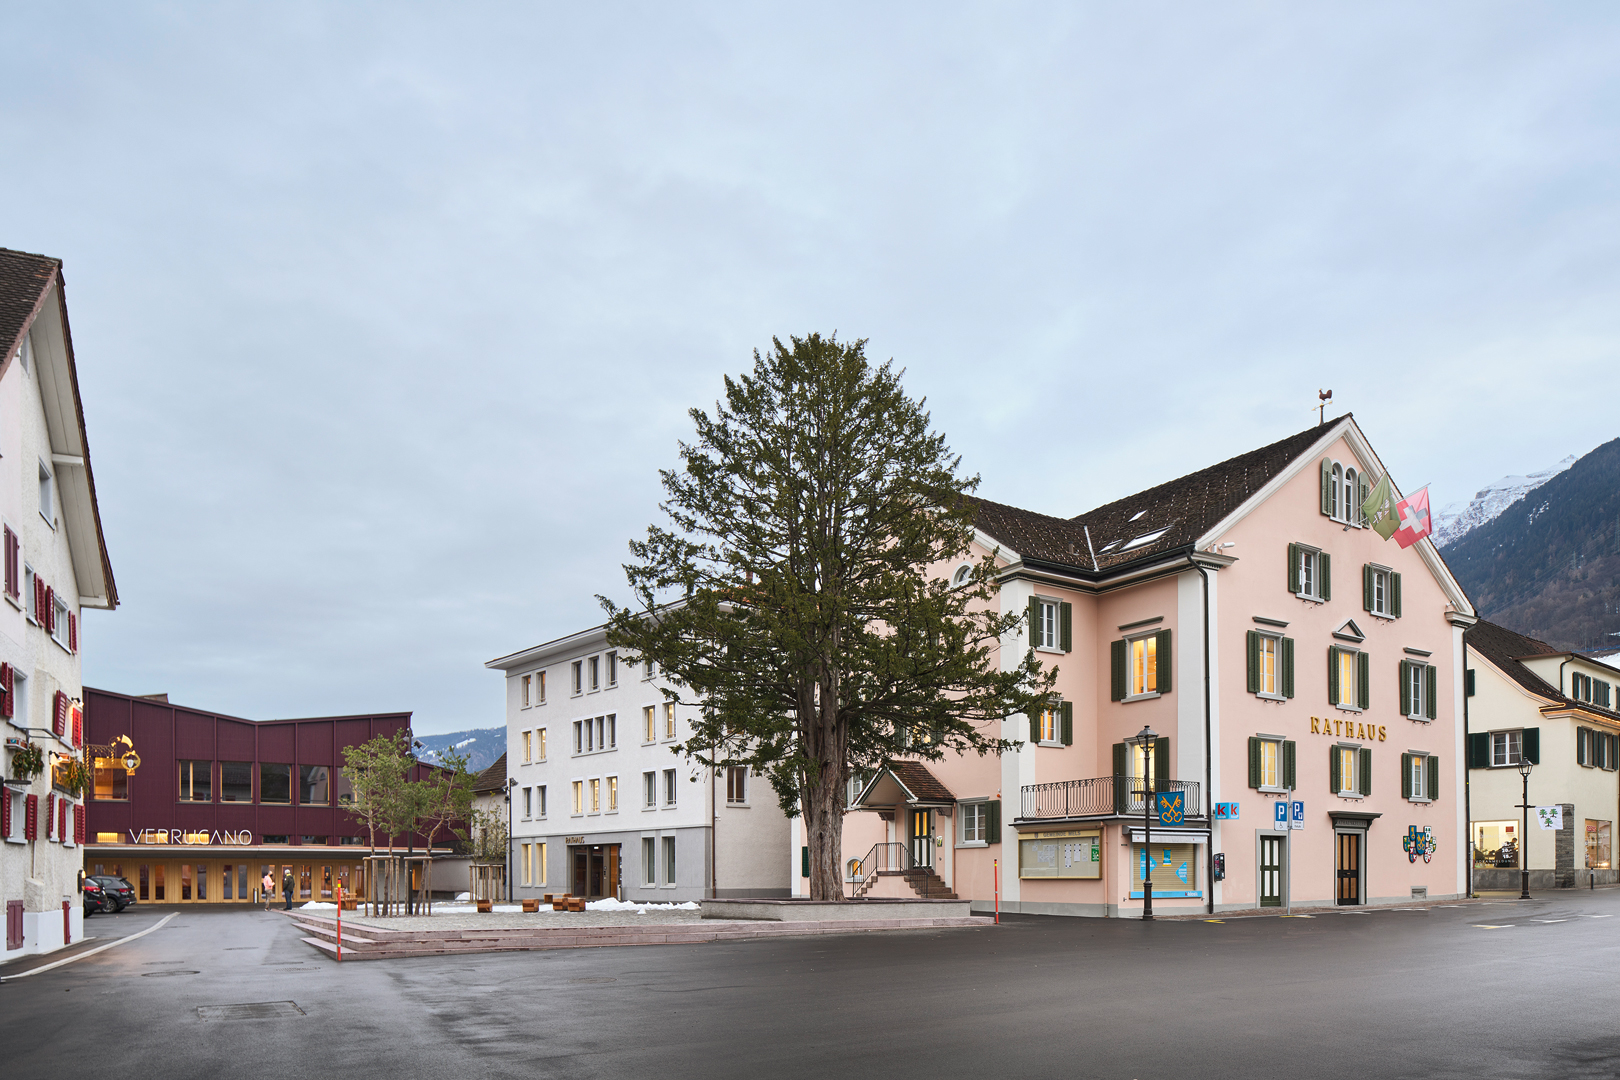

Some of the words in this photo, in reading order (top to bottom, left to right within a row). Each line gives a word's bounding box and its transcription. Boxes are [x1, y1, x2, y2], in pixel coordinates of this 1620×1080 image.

[1310, 716, 1387, 742] RATHAUS
[1217, 804, 1226, 815] k
[1231, 804, 1237, 815] k
[1278, 805, 1285, 819] P
[1294, 803, 1300, 816] P
[129, 828, 253, 845] VERRUCANO
[565, 836, 585, 844] RATHAUS
